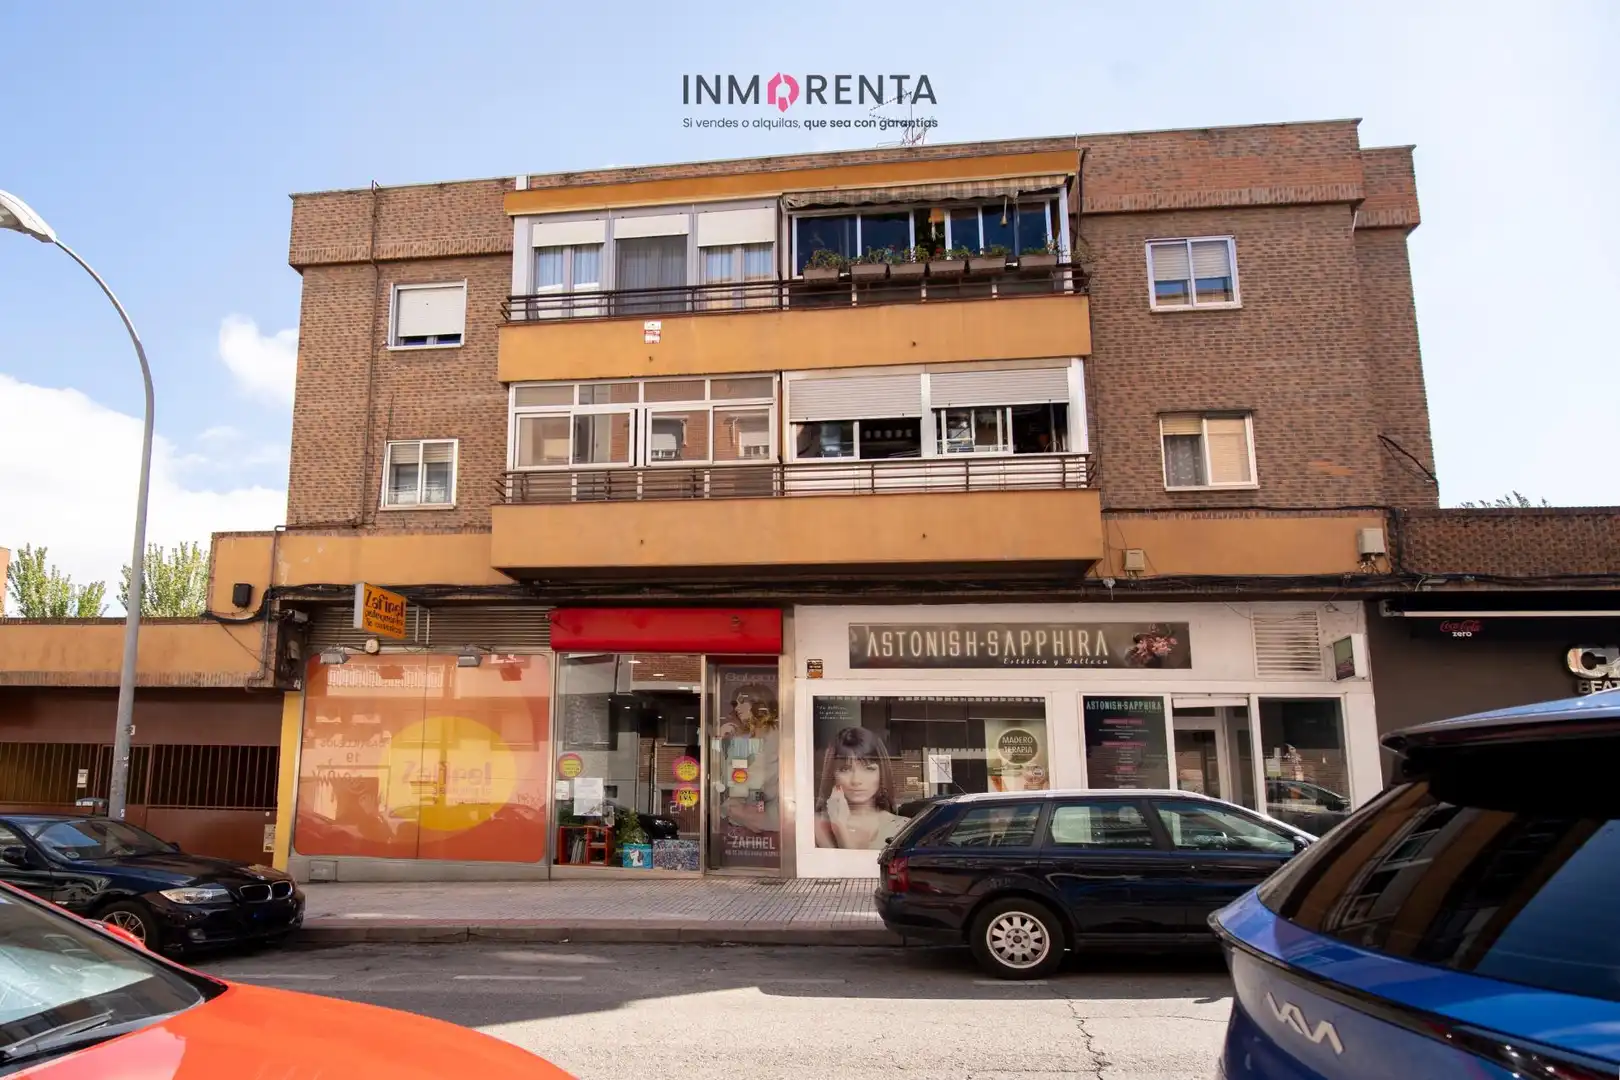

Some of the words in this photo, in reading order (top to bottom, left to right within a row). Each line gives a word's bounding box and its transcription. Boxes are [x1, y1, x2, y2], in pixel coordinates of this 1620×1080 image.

[1053, 659, 1061, 667] y
[1002, 736, 1033, 744] MADERO
[1003, 745, 1033, 753] TERAPIA
